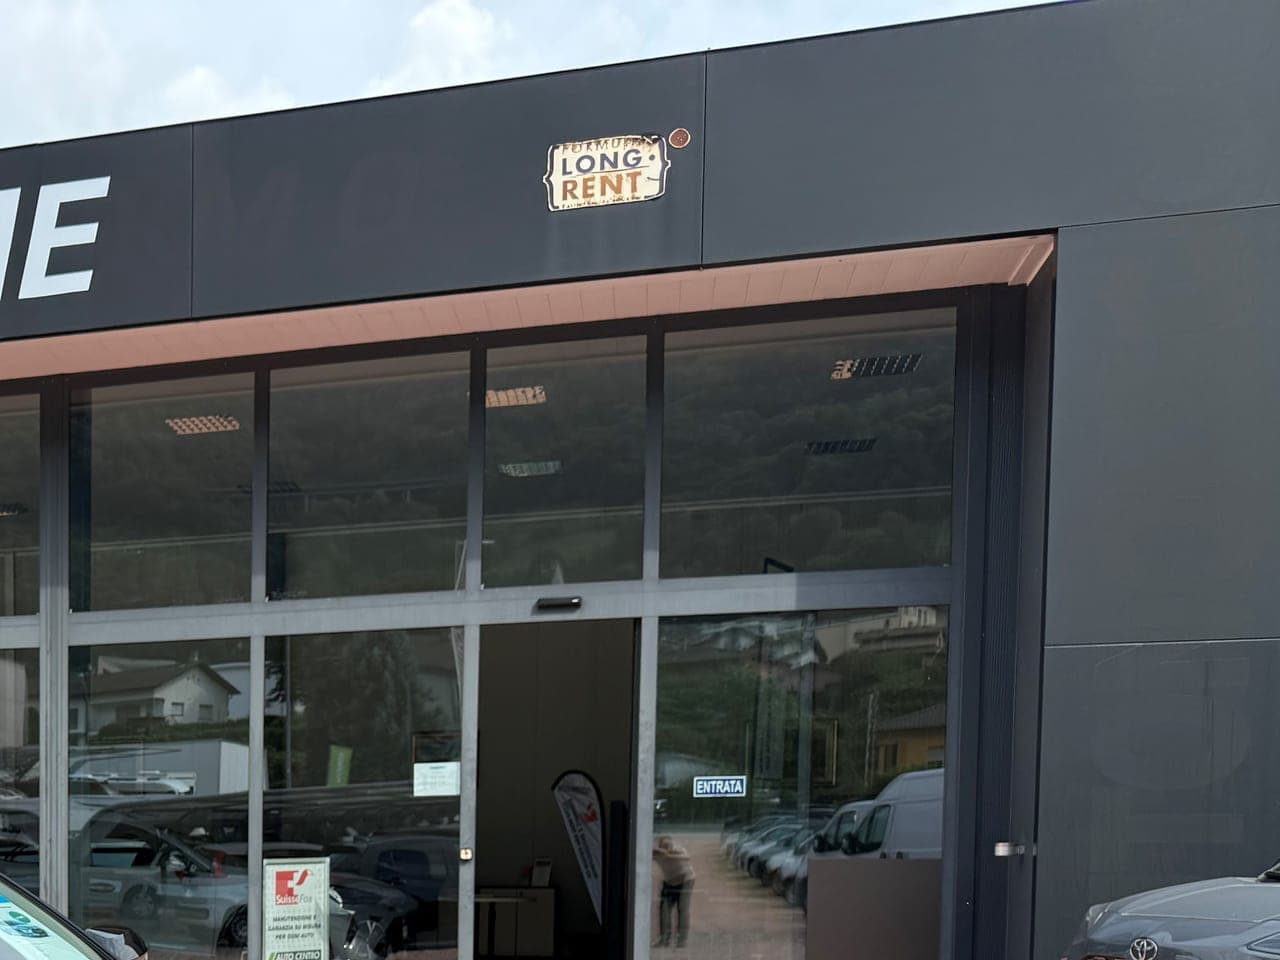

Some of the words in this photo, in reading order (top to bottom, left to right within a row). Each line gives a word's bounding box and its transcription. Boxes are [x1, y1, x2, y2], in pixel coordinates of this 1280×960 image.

[562, 149, 642, 176] LONG
[562, 171, 642, 201] RENT
[697, 780, 742, 793] ENTRATA
[276, 952, 294, 960] AUTO
